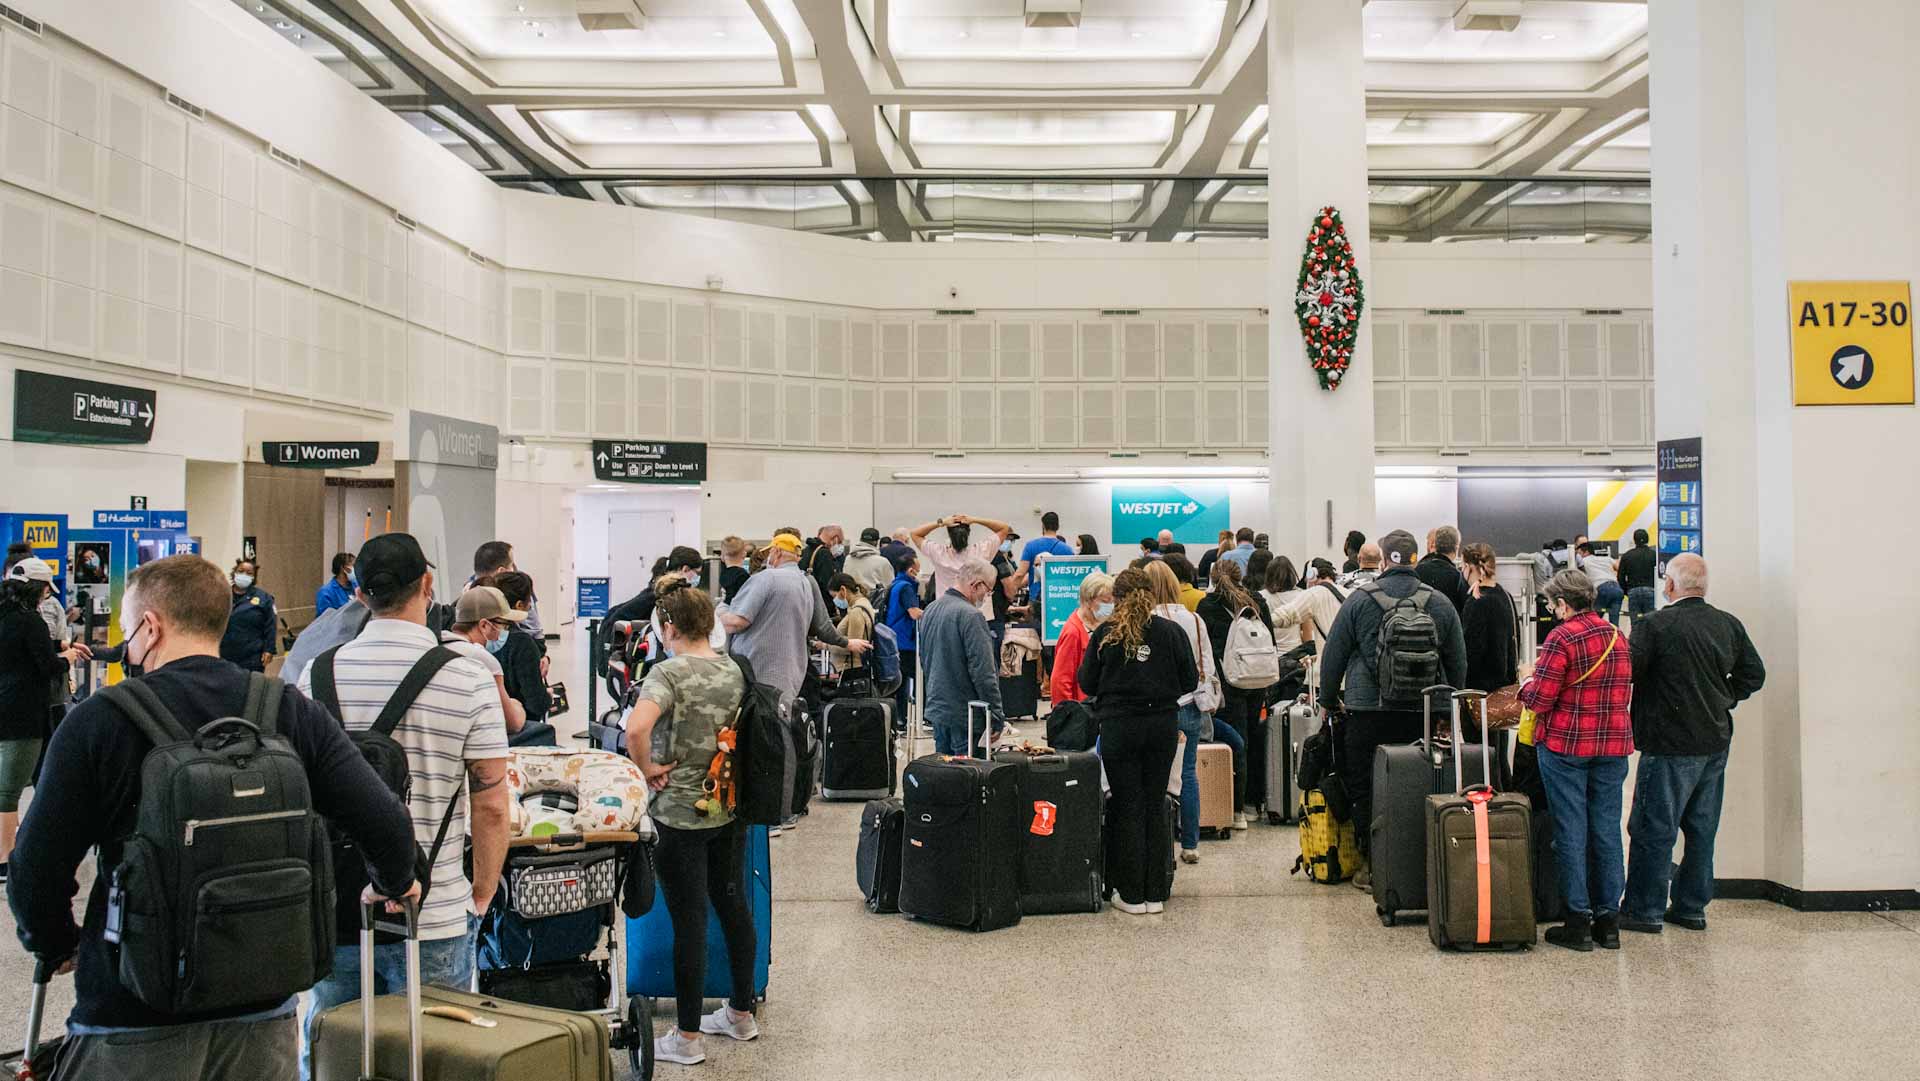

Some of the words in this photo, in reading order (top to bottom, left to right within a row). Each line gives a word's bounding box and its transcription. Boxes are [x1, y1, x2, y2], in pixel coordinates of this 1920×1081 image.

[1799, 302, 1907, 327] A17-30
[90, 395, 119, 414] Parking
[438, 424, 481, 456] Women
[302, 446, 360, 460] Women
[625, 444, 650, 453] Parking
[1120, 503, 1181, 518] WESTJET
[108, 514, 144, 523] Hudson
[26, 526, 56, 542] ATM
[175, 544, 192, 555] PPE
[1050, 566, 1090, 576] WESTJET
